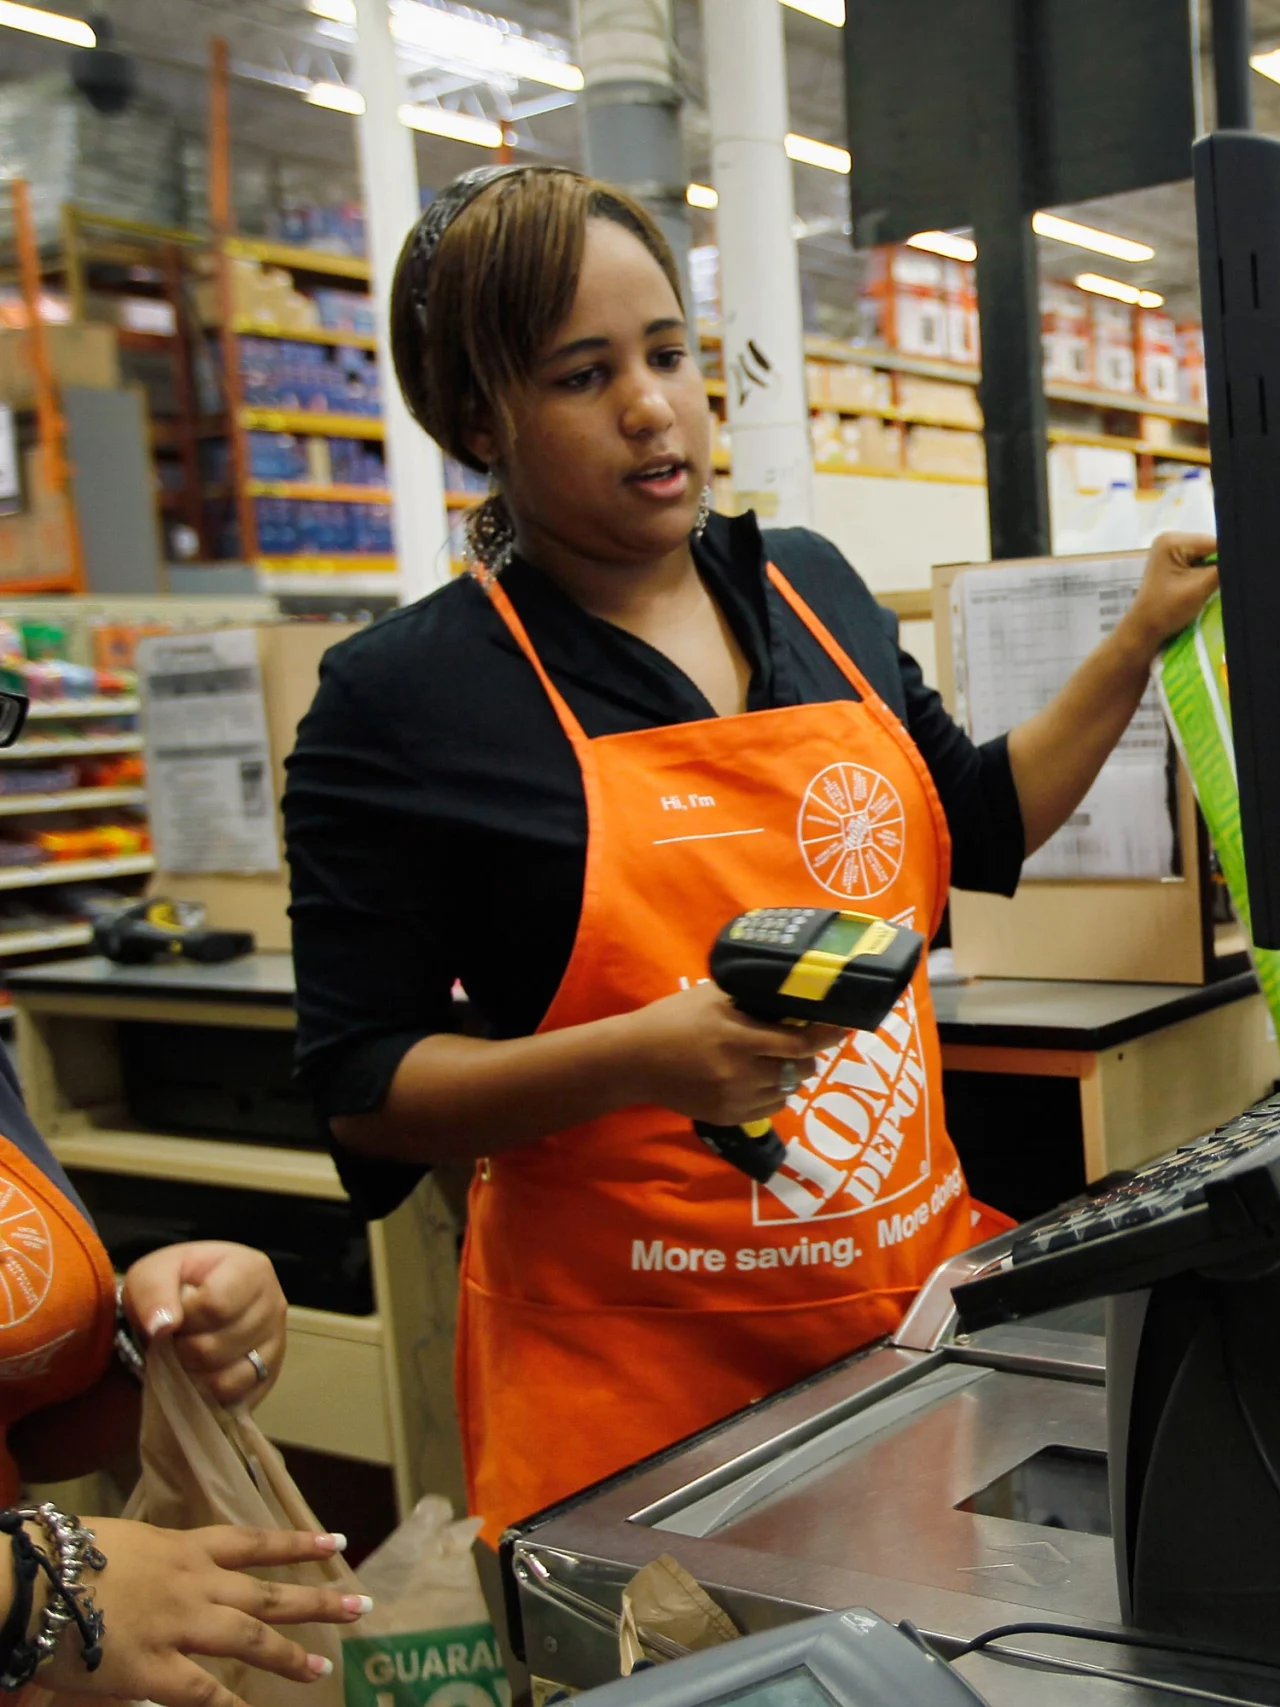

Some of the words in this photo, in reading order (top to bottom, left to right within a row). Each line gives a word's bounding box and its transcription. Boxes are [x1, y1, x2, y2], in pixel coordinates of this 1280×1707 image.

[660, 794, 689, 812] Hi,
[687, 792, 717, 808] I'm
[764, 994, 917, 1220] HOME
[843, 1046, 926, 1207] DEPOT
[630, 1239, 727, 1272] More
[734, 1236, 864, 1268] saving.
[877, 1201, 930, 1250] More
